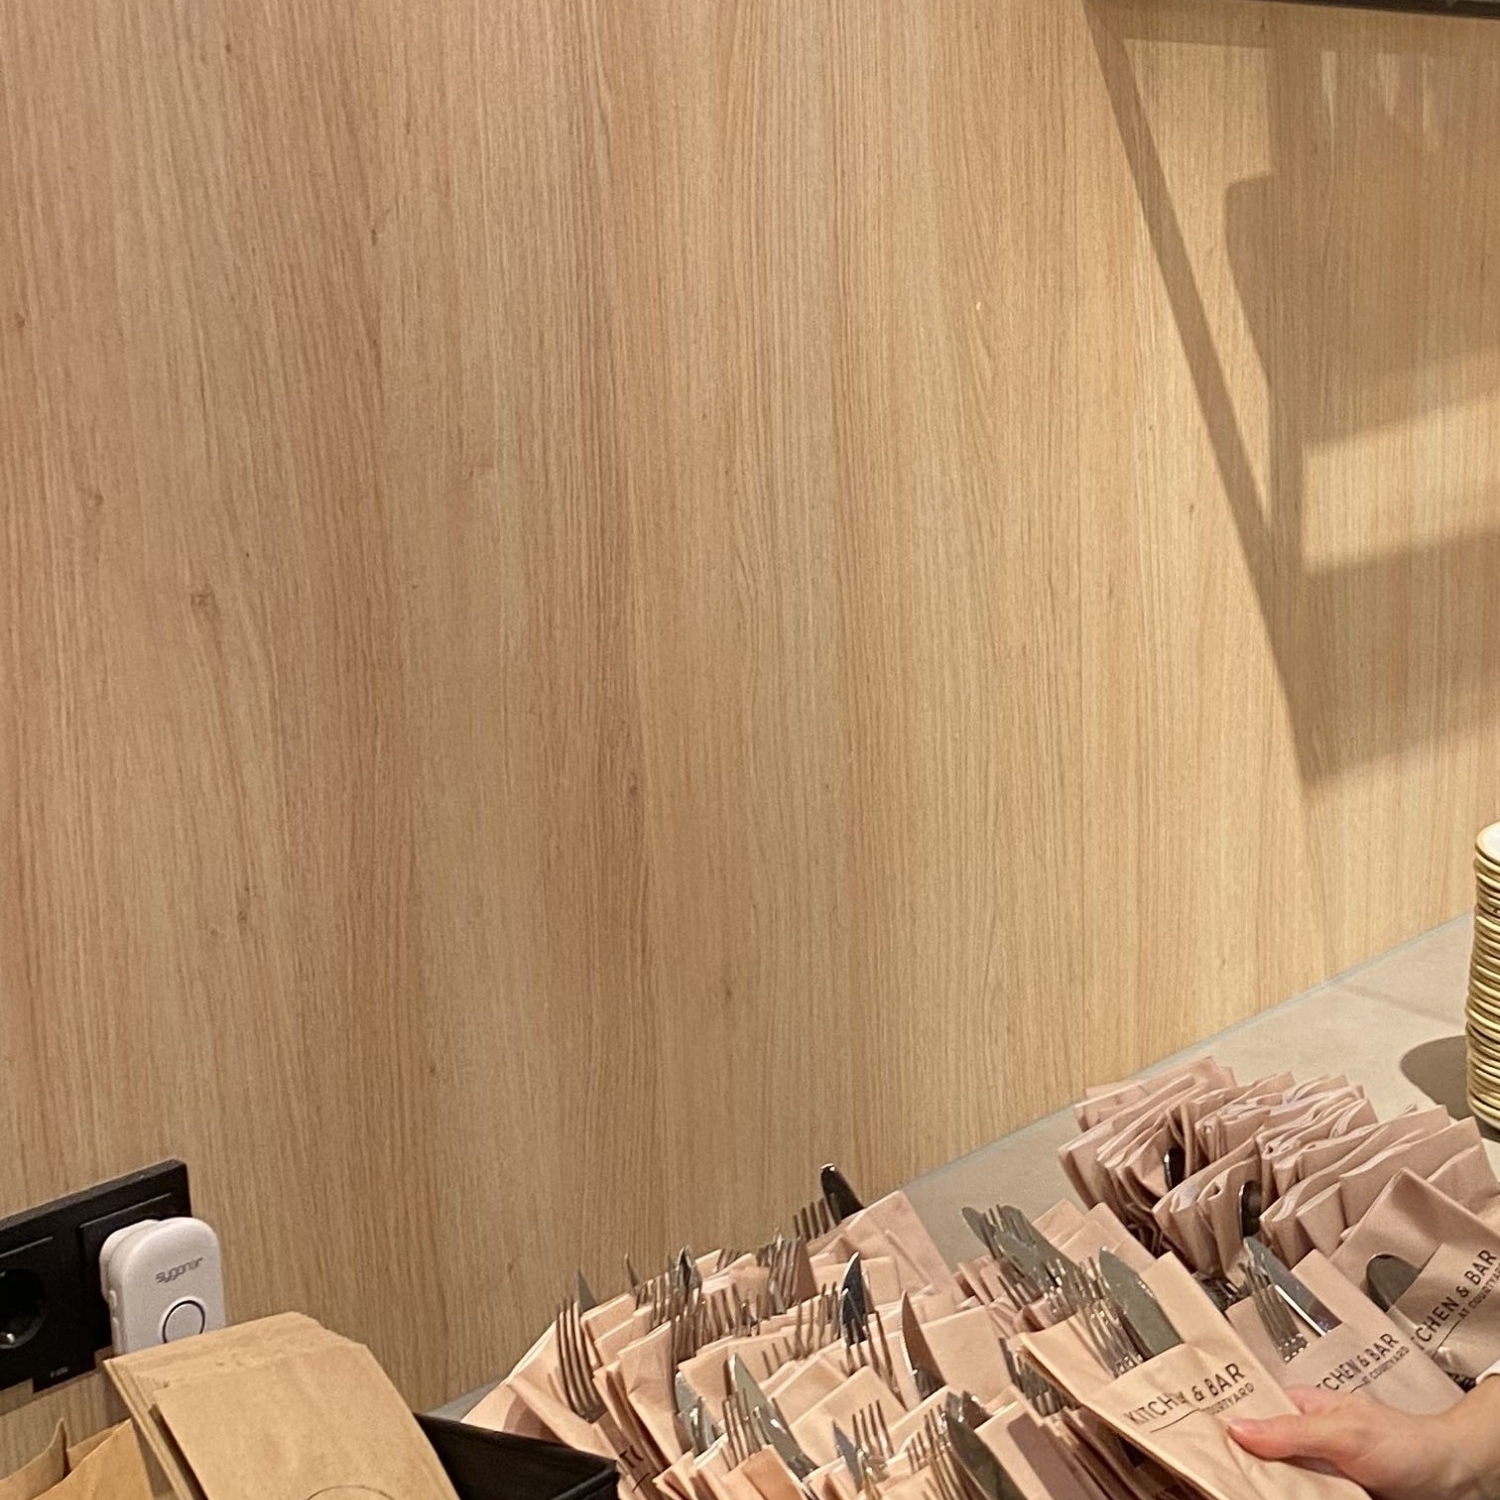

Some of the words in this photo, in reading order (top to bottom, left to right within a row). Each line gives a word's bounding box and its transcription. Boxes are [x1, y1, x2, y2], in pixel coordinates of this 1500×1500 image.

[1455, 1285, 1470, 1299] &
[1464, 1249, 1498, 1286] BAR
[1364, 1333, 1399, 1362] BAR
[1191, 1384, 1205, 1402] &
[1204, 1362, 1246, 1397] BAR
